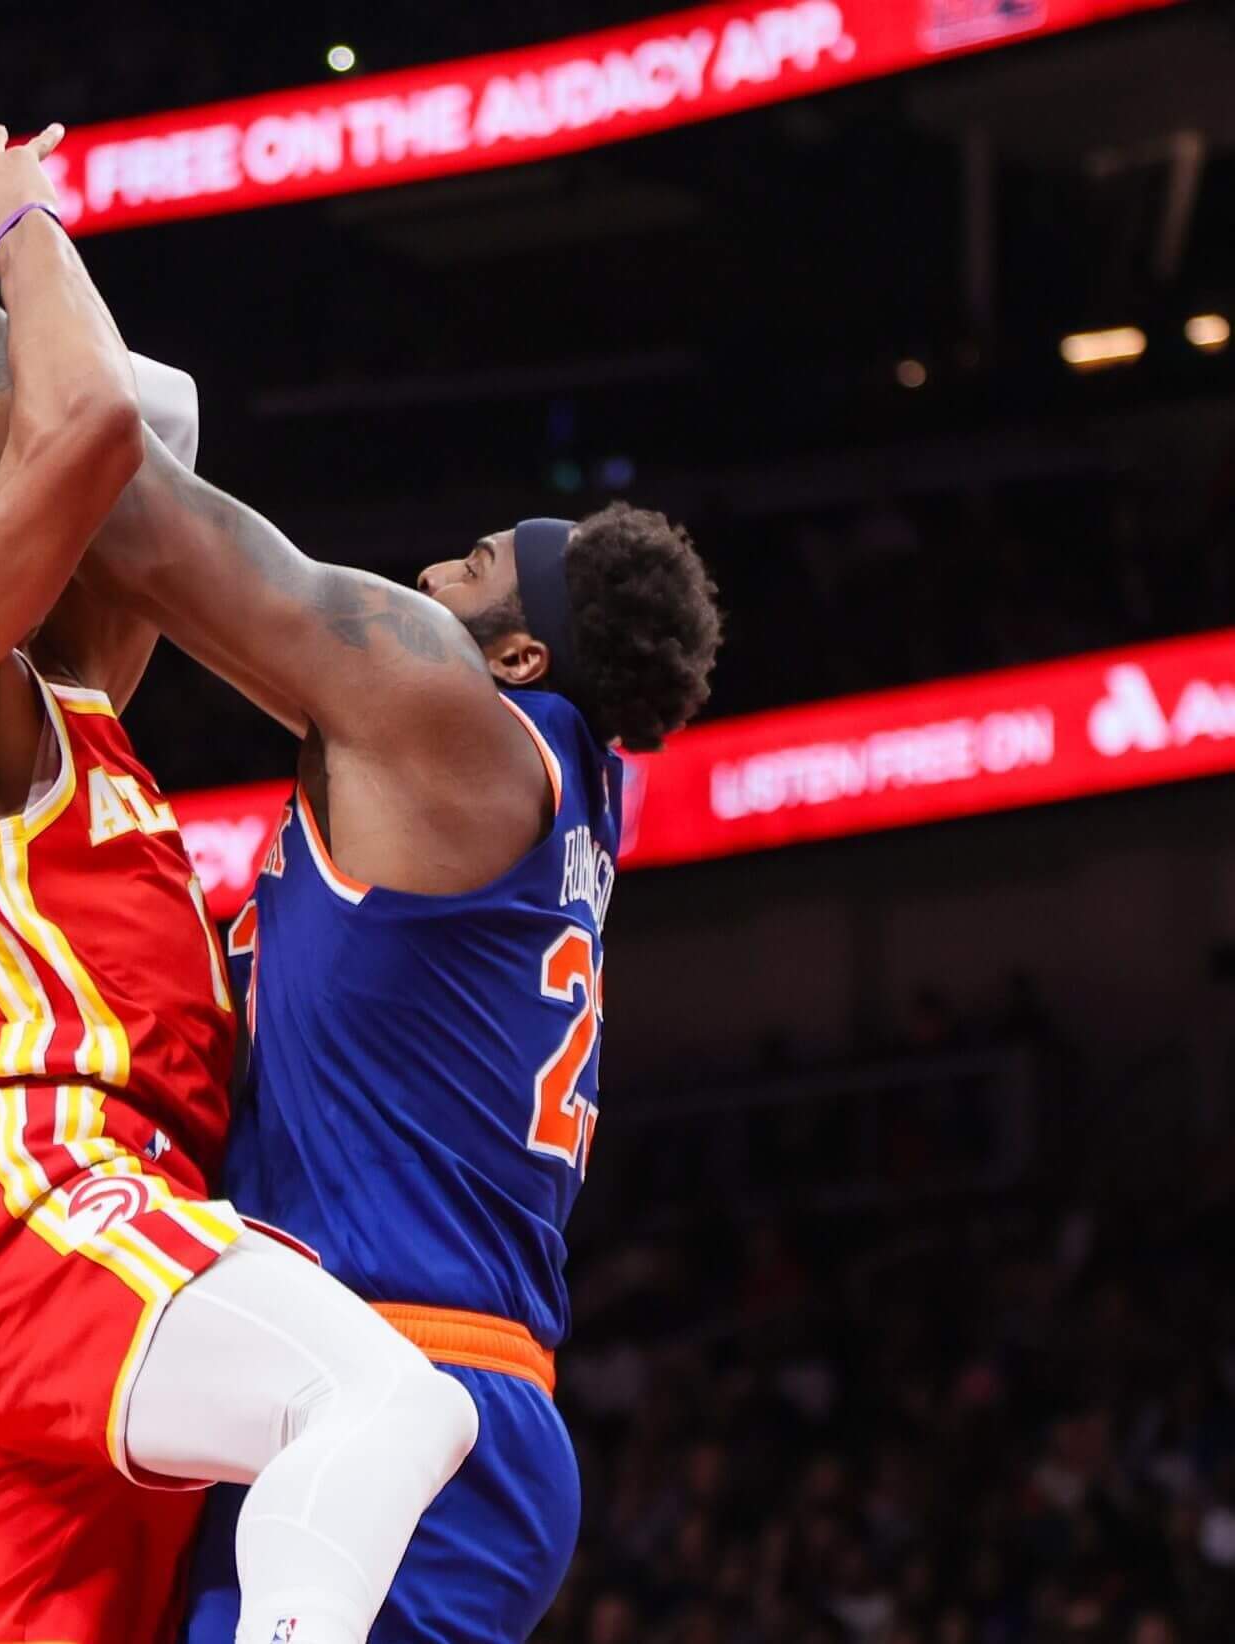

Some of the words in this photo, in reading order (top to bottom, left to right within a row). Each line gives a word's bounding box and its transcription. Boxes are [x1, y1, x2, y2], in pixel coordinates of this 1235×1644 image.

[85, 125, 243, 212] FREE
[243, 110, 342, 183] ON
[342, 86, 471, 166] THE
[473, 34, 712, 144] AUDACY
[712, 745, 863, 818] LISTEN
[863, 720, 976, 791] FREE
[977, 709, 1054, 772] ON
